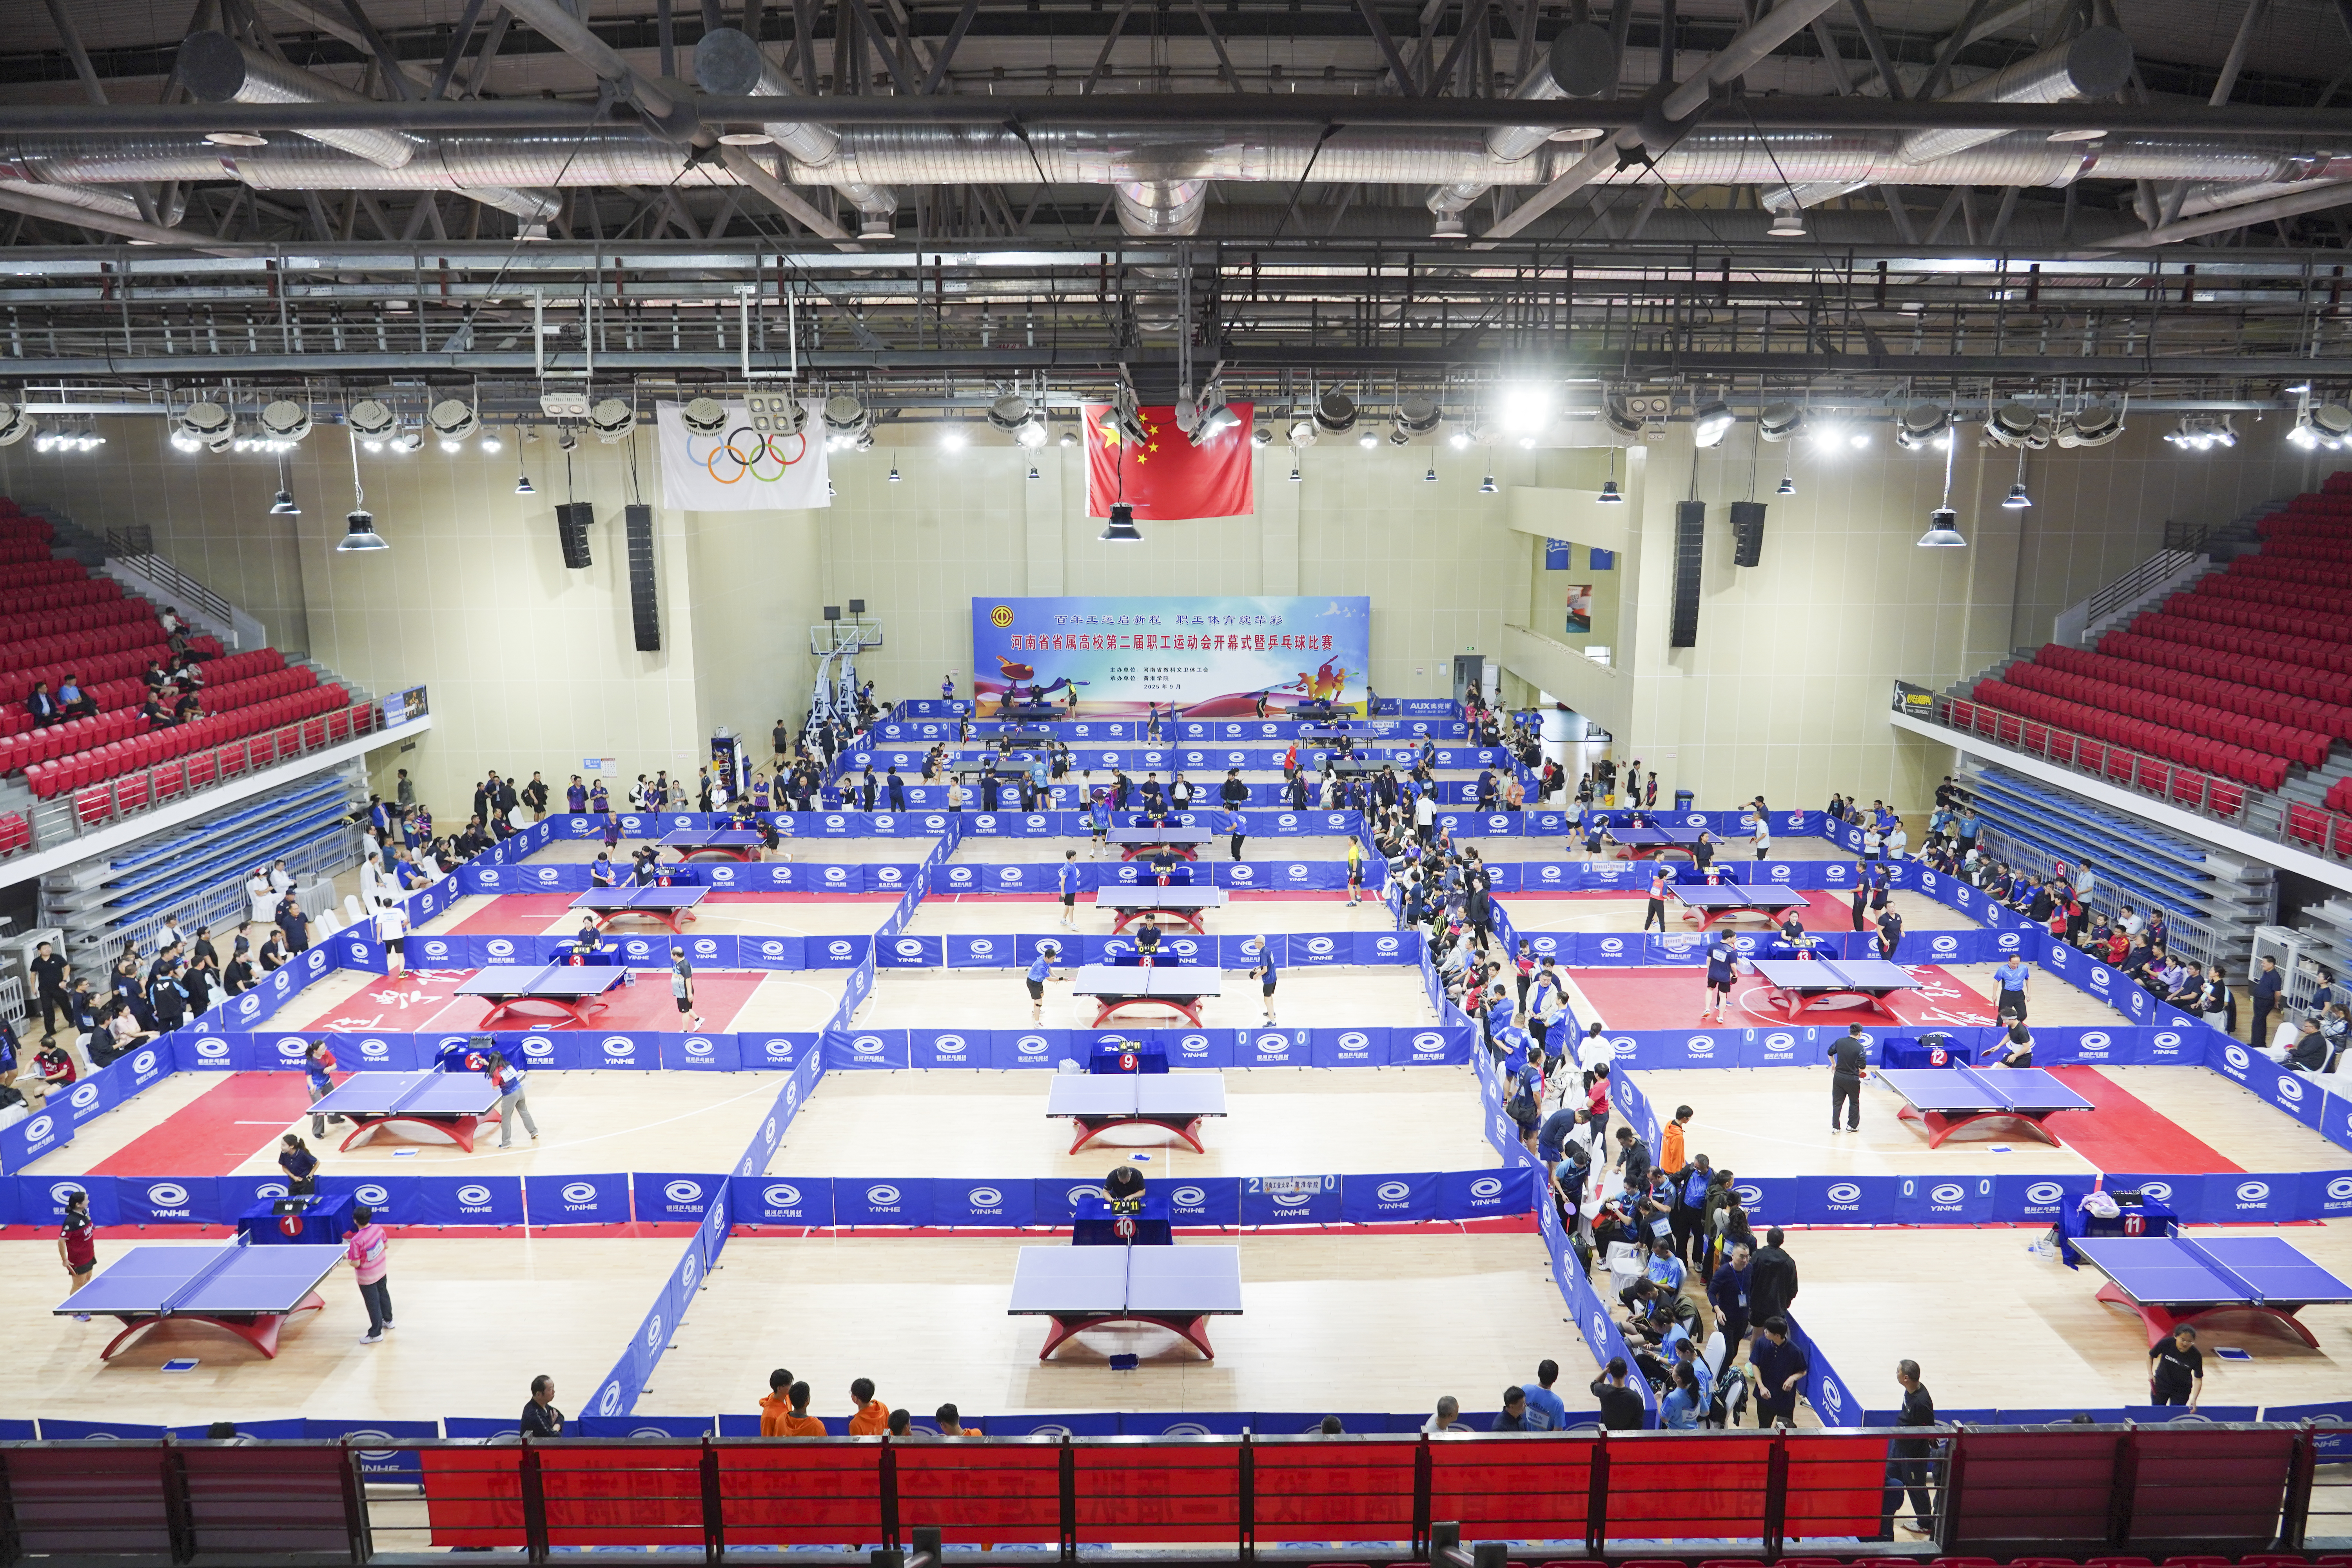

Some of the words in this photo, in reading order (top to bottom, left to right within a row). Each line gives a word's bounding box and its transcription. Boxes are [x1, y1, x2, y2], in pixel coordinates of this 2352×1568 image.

[1054, 615, 1162, 625] 百年工运启新程
[1176, 615, 1283, 625] 职工体育绽华彩
[1011, 634, 1333, 651] 河南省省属高校第二届职工运动会开幕式暨乒乓球比赛
[736, 822, 742, 831] 5
[1633, 820, 1642, 828] 15
[1583, 863, 1589, 872] 0
[1627, 862, 1633, 871] 2
[2058, 864, 2063, 875] G
[662, 876, 668, 887] 4
[1160, 876, 1167, 884] 7
[1708, 876, 1718, 884] 14
[1957, 897, 1968, 907] YINHE
[423, 906, 434, 914] YINHE
[1654, 935, 1659, 946] 1
[1705, 933, 1710, 943] 1
[573, 955, 582, 966] 3
[1798, 952, 1808, 960] 13
[1143, 958, 1151, 967] 8
[2052, 960, 2065, 969] YINHE
[2131, 1006, 2141, 1017] YINHE
[1239, 1032, 1247, 1044] 0
[1297, 1031, 1305, 1044] 0
[1746, 1029, 1754, 1041] 0
[1808, 1028, 1815, 1040] 0
[470, 1055, 481, 1070] 2
[1124, 1056, 1133, 1069] 9
[1932, 1050, 1945, 1064] 12
[811, 1064, 820, 1080] YINHE
[2224, 1064, 2247, 1080] YINHE
[2276, 1095, 2300, 1113] YINHE
[766, 1138, 777, 1158] YINHE
[1249, 1178, 1260, 1194] 2
[1325, 1175, 1335, 1189] 0
[1904, 1180, 1914, 1196] 0
[1980, 1179, 1990, 1194] 0
[1114, 1202, 1120, 1210] 7
[1131, 1201, 1138, 1210] 11
[285, 1216, 295, 1234] 1
[715, 1221, 725, 1241] YINHE
[1115, 1220, 1134, 1237] 10
[1541, 1218, 1551, 1239] YINHE
[2125, 1216, 2141, 1234] 11
[1563, 1270, 1573, 1292] YINHE
[649, 1336, 662, 1359] YINHE
[1593, 1335, 1605, 1356] YINHE
[1821, 1397, 1840, 1426] YINHE
